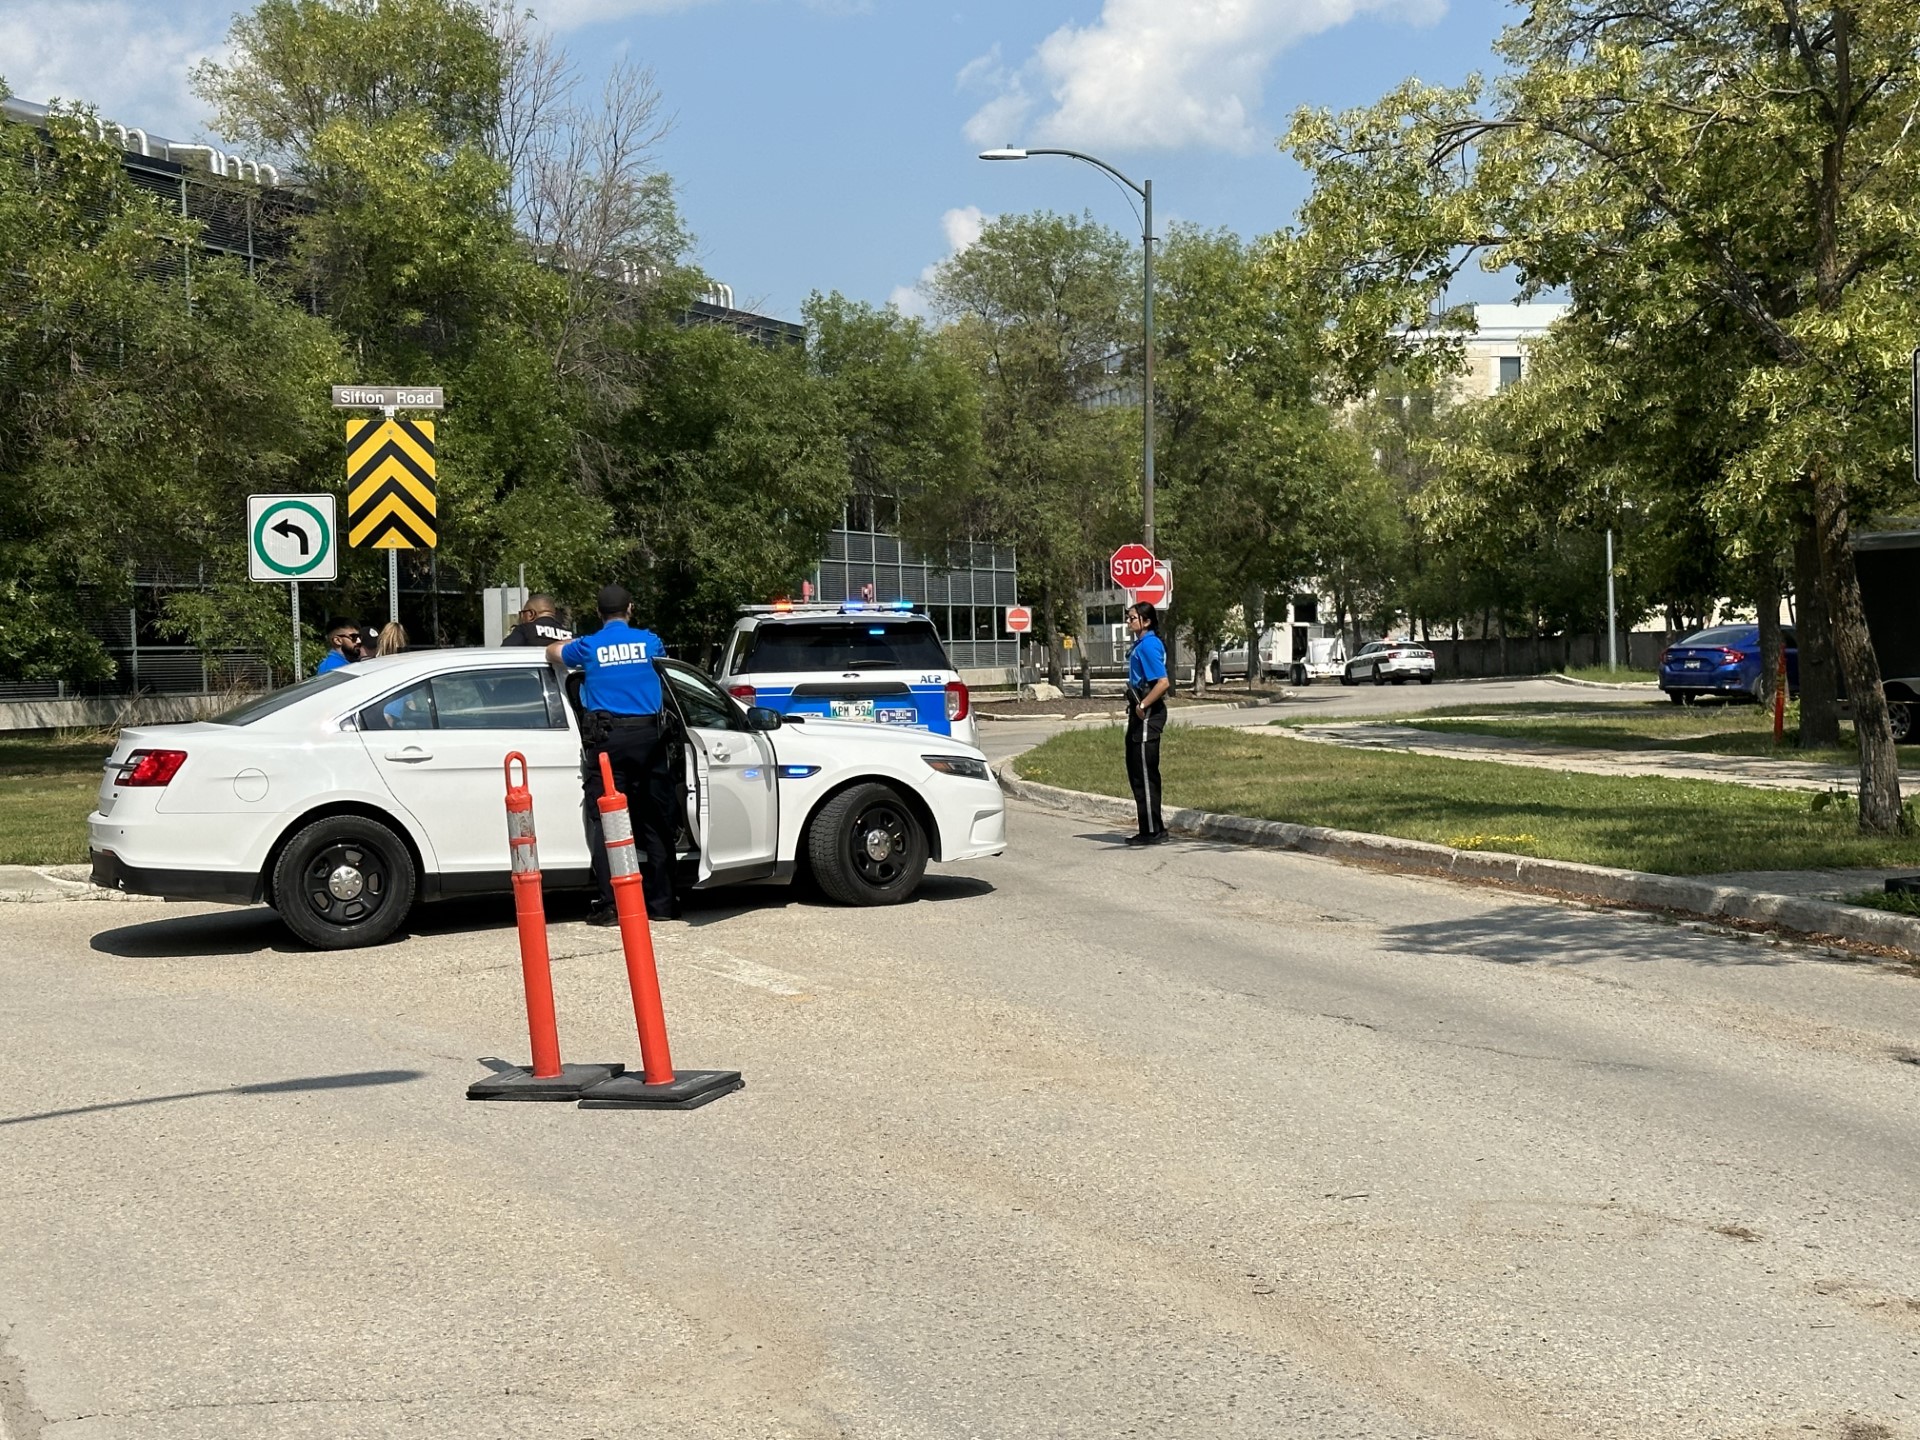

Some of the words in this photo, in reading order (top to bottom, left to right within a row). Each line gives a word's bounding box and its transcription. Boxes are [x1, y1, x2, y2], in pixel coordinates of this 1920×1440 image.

[340, 390, 385, 404] Sifton
[396, 391, 434, 404] Road
[1114, 558, 1152, 576] STOP
[535, 624, 573, 641] POLICE
[596, 642, 647, 663] CADET
[832, 705, 848, 717] KPM
[854, 705, 871, 717] 596
